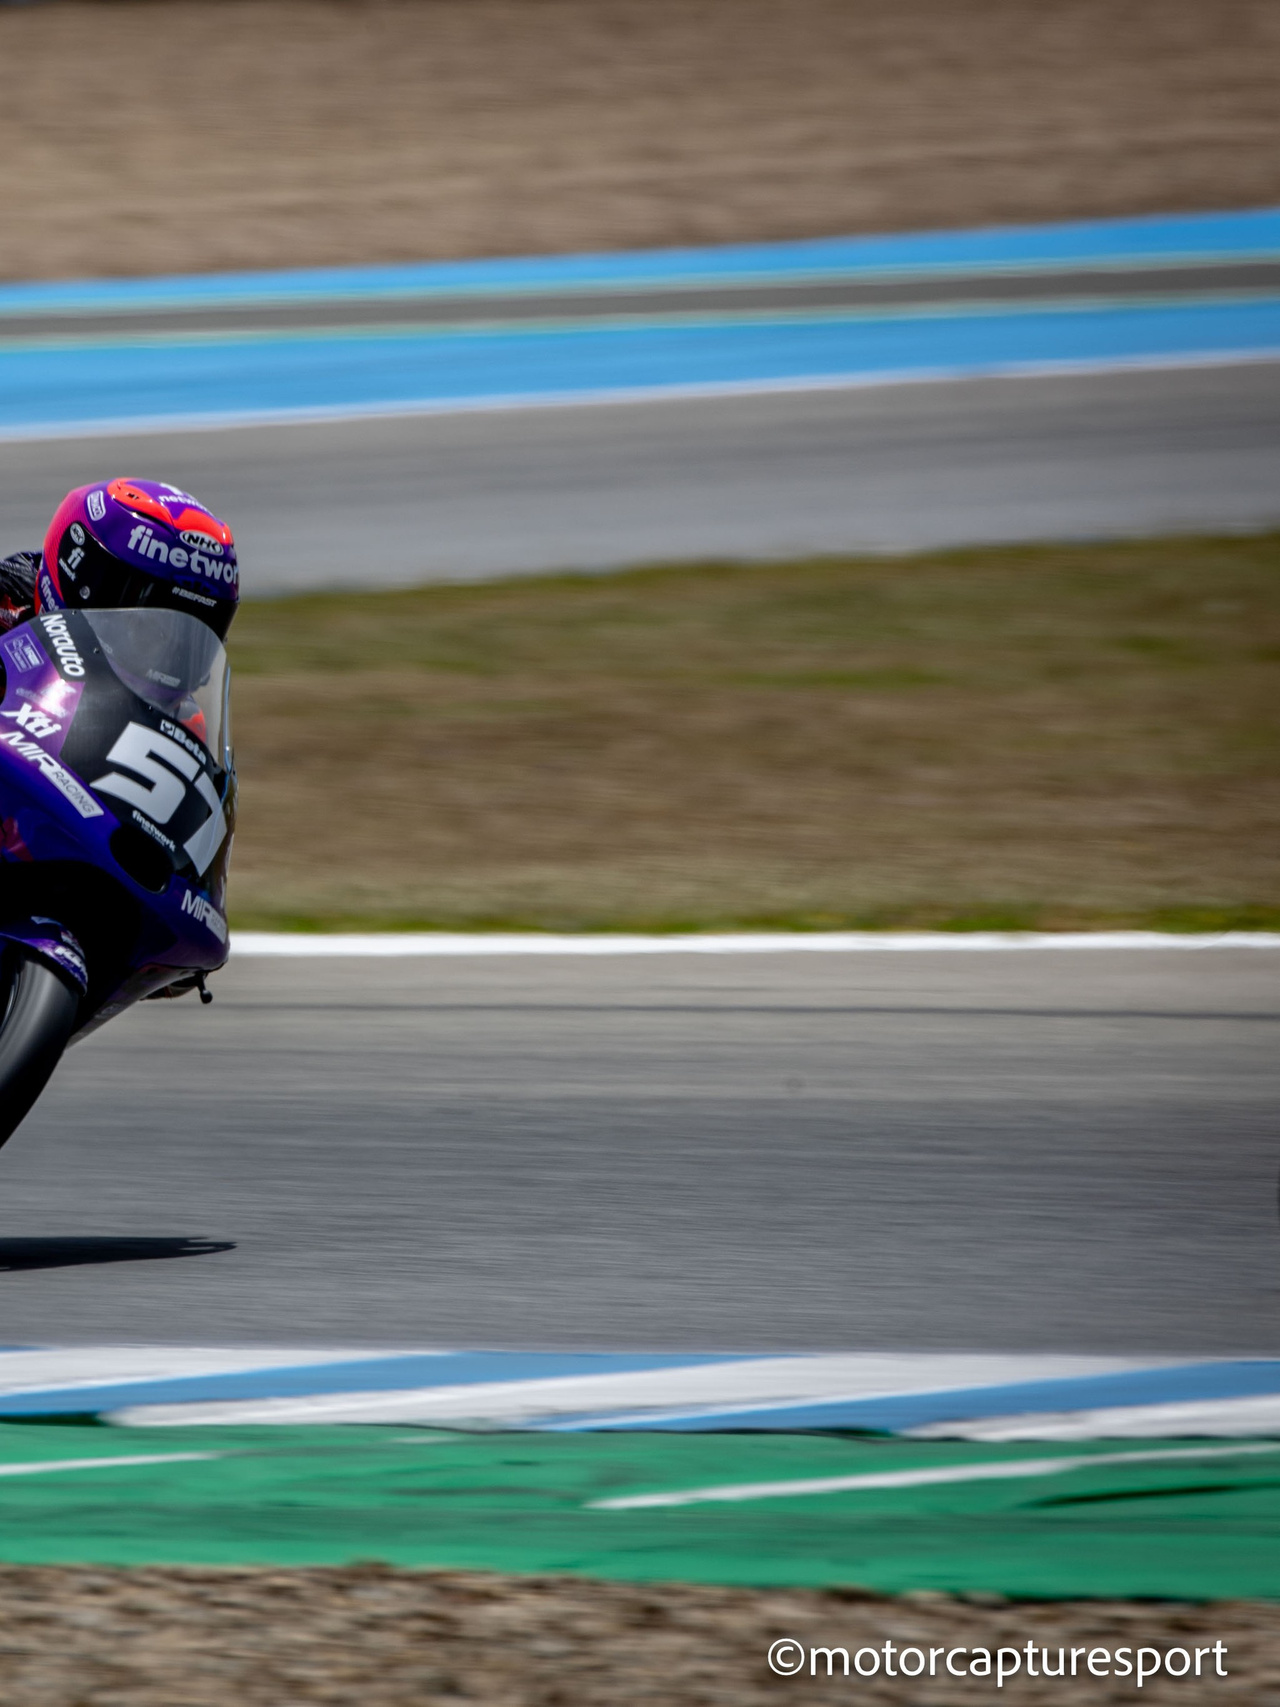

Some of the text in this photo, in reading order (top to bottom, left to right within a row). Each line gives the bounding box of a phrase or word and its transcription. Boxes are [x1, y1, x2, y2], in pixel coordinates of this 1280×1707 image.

[127, 525, 239, 584] finetwor
[187, 533, 219, 551] NHK
[40, 613, 85, 678] Norauto
[0, 702, 62, 738] Xti
[174, 726, 207, 765] Beta
[0, 731, 95, 813] MIR RACING
[132, 810, 176, 852] finetwork
